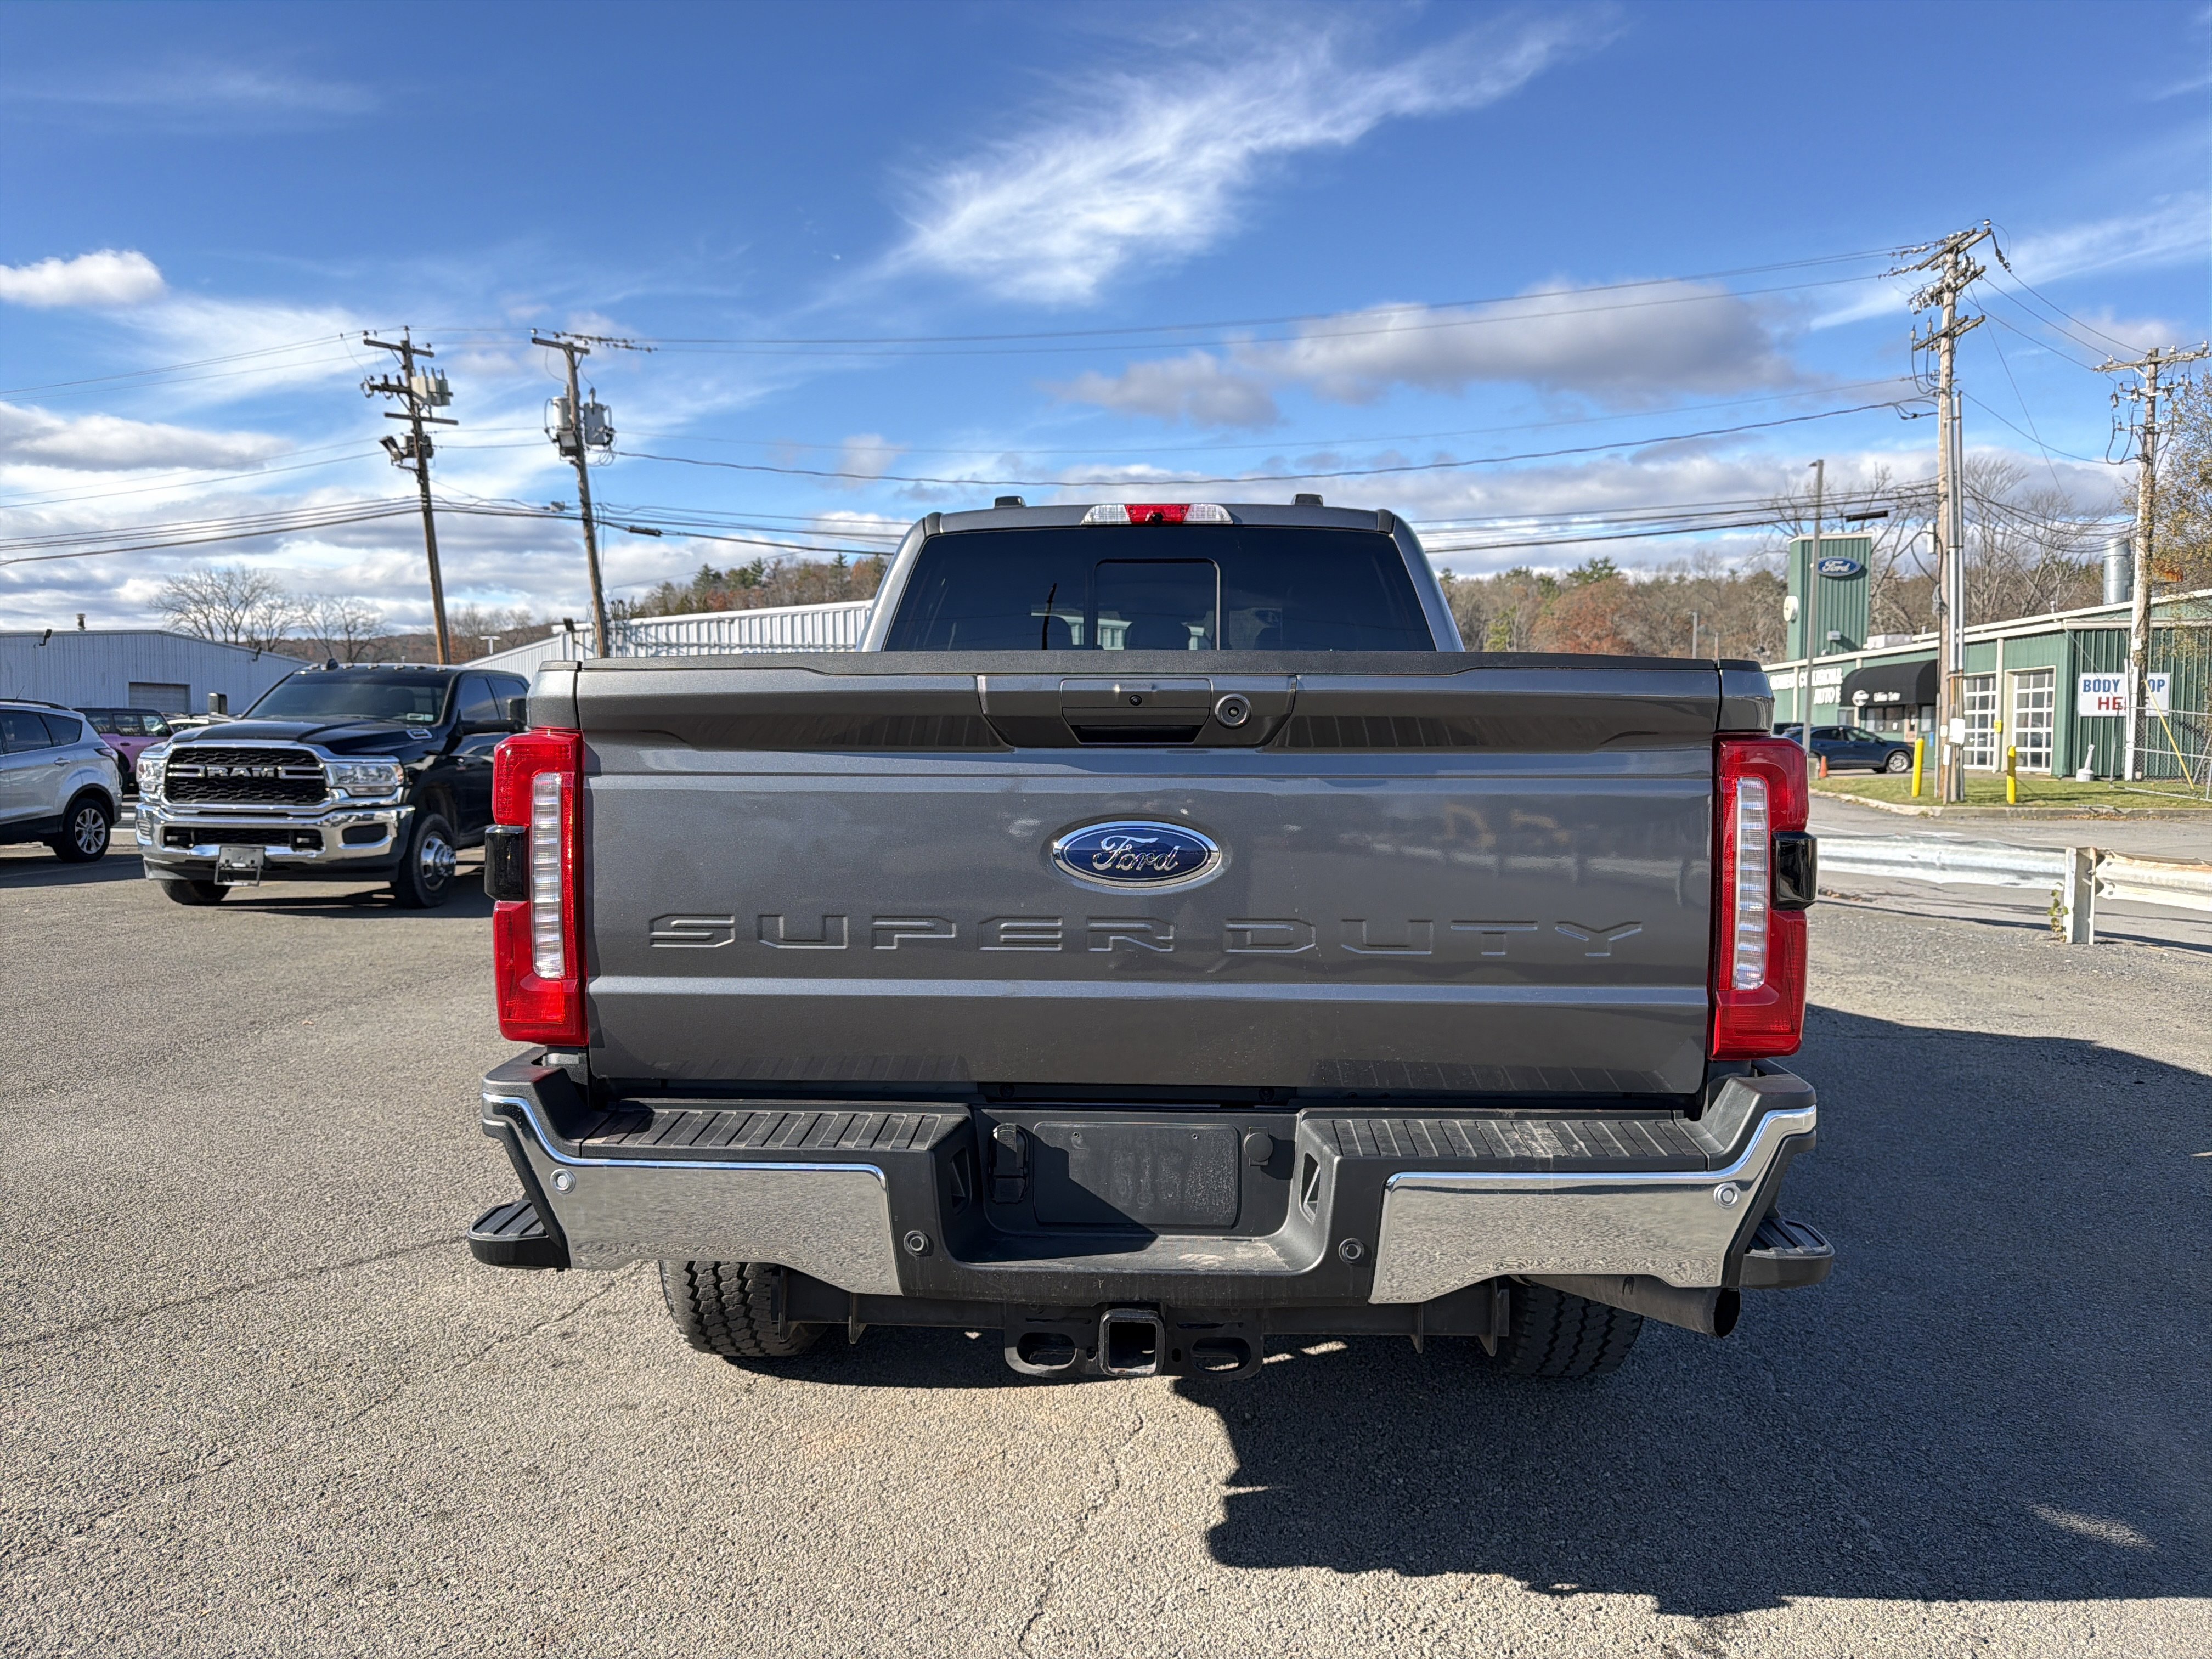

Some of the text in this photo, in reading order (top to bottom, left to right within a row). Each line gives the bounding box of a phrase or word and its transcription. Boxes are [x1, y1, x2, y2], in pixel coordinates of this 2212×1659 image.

[1822, 560, 1850, 572] Ford
[2083, 679, 2165, 693] BODY OP
[1813, 687, 1835, 704] AUTO
[207, 766, 275, 778] RAM
[1092, 834, 1181, 871] Ford
[649, 913, 1643, 957] SUPER DUTY
